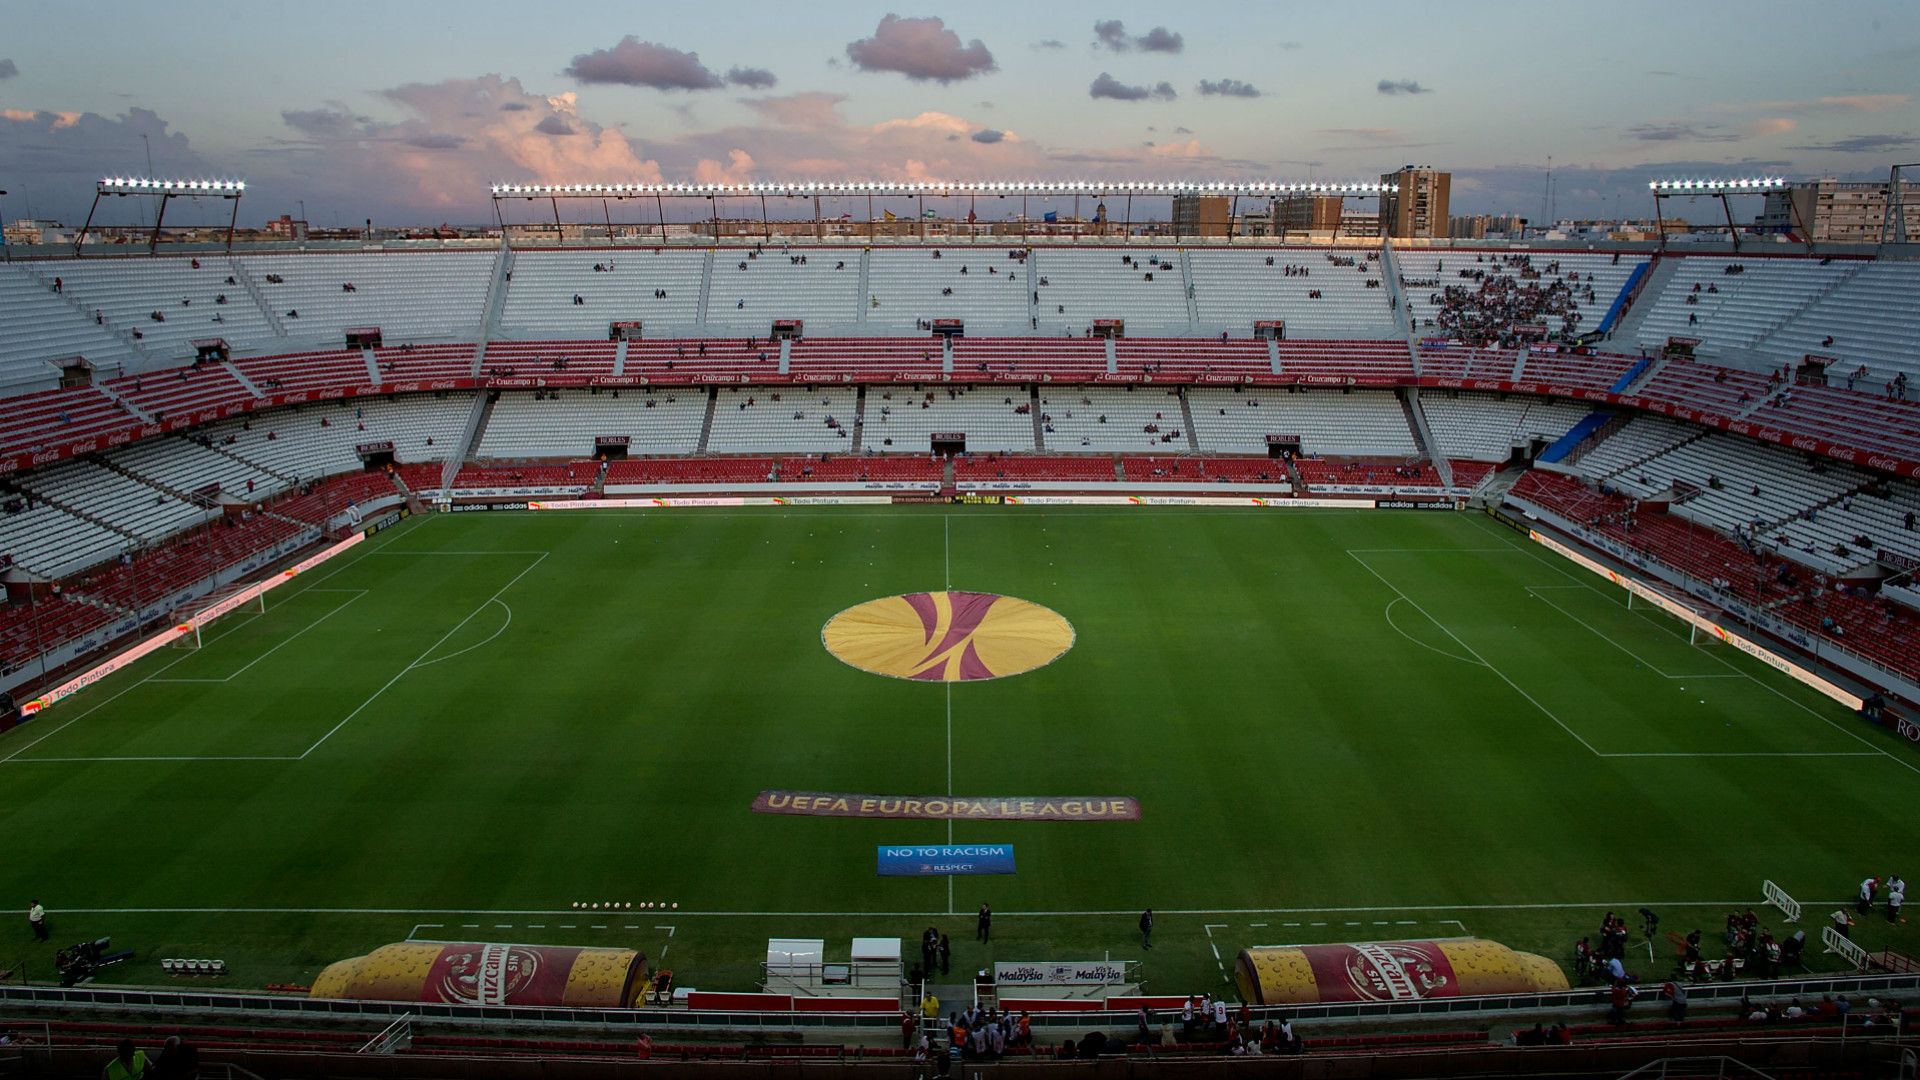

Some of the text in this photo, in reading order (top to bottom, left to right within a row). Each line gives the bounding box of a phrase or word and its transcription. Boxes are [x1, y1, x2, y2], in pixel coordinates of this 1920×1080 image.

[600, 376, 634, 384] Cruzcampo
[804, 373, 836, 381] Cruzcampo
[904, 372, 936, 380] Cruzcampo
[1004, 372, 1038, 380] Cruzcampo
[1104, 373, 1138, 381] Cruzcampo
[1206, 374, 1238, 382] Cruzcampo
[1308, 375, 1340, 383] Cruzcampo
[496, 378, 530, 386] Cruzcampo
[1736, 638, 1790, 673] Todo Pintura
[56, 663, 115, 700] Todo Pintura
[767, 794, 1128, 816] UEFA EUROPA LEAGUE
[888, 847, 1004, 857] NO TO RACISM
[508, 955, 518, 972] SIN
[998, 971, 1043, 982] Malaysia
[1075, 970, 1120, 980] Malaysia
[1366, 970, 1388, 990] SIN
[1218, 1006, 1224, 1014] 9
